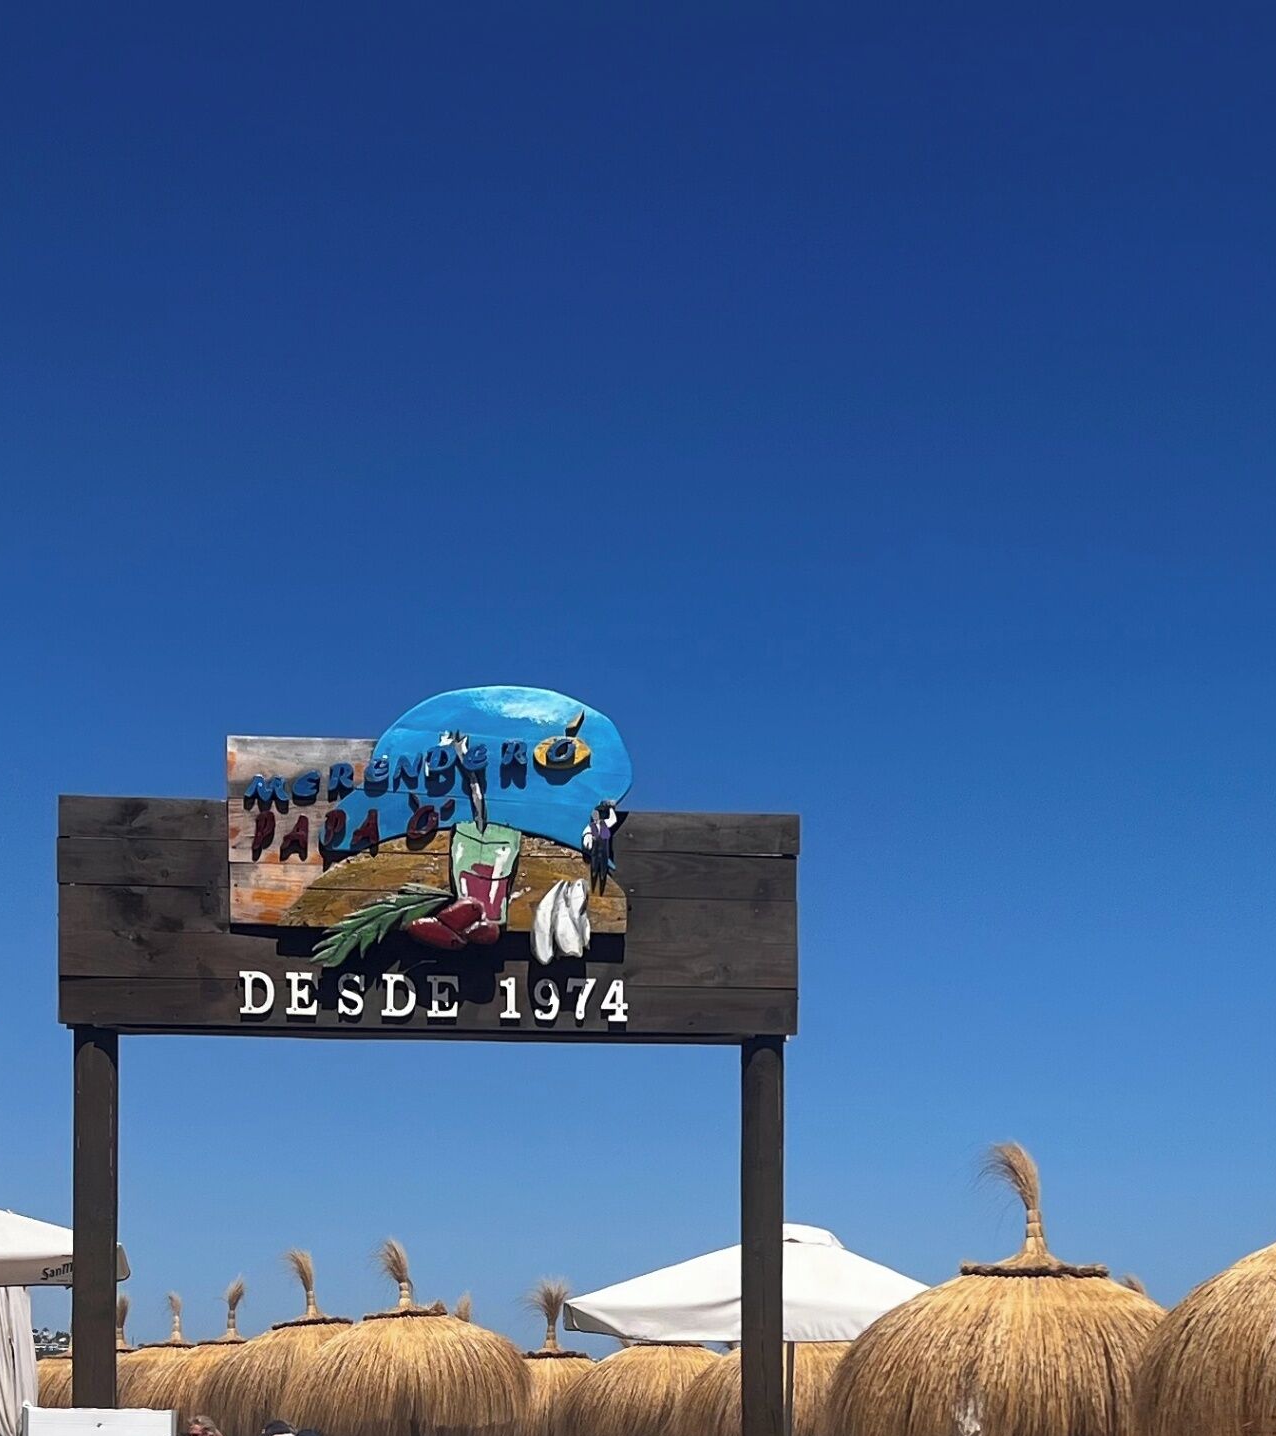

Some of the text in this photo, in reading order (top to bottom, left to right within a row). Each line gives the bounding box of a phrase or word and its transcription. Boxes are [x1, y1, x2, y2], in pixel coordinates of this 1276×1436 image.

[243, 738, 575, 802] MERENDERO
[254, 809, 380, 853] PAPA
[238, 970, 629, 1023] DESDE 1974
